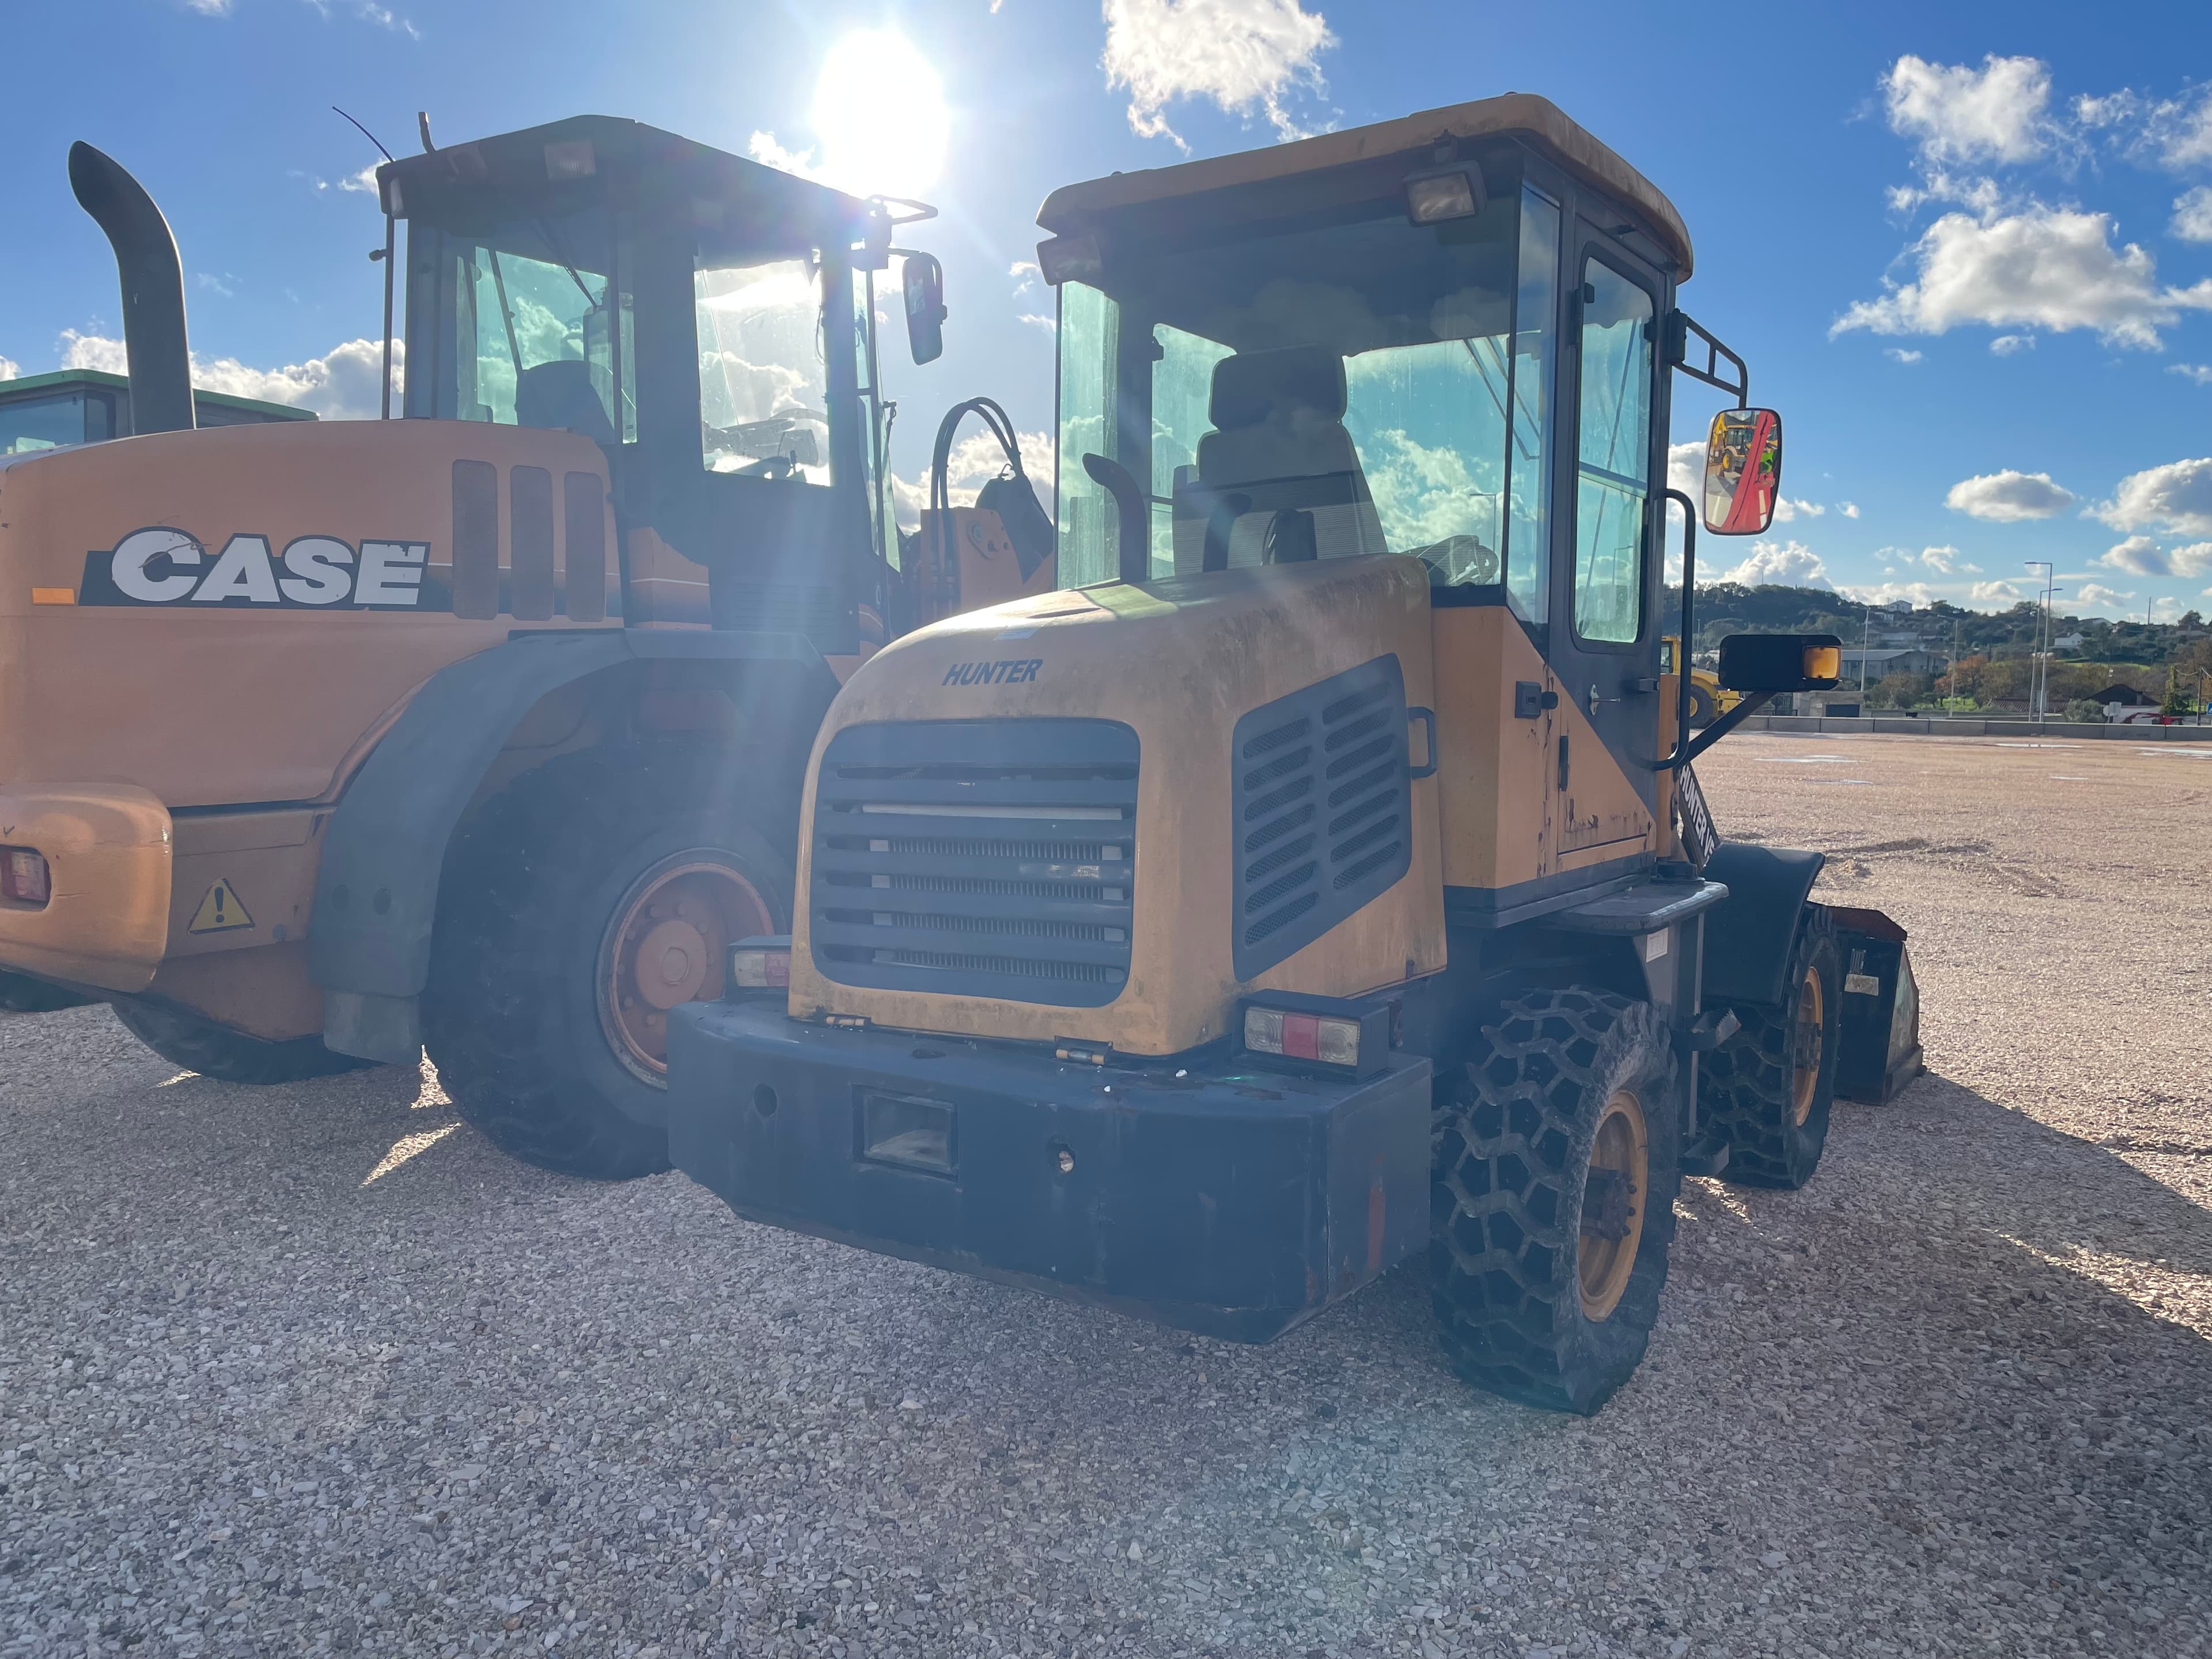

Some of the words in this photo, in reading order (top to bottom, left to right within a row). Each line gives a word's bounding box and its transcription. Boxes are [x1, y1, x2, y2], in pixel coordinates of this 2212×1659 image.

[110, 529, 427, 605] CASE
[941, 658, 1043, 686] HUNTER
[1679, 764, 1707, 847] HUNTER
